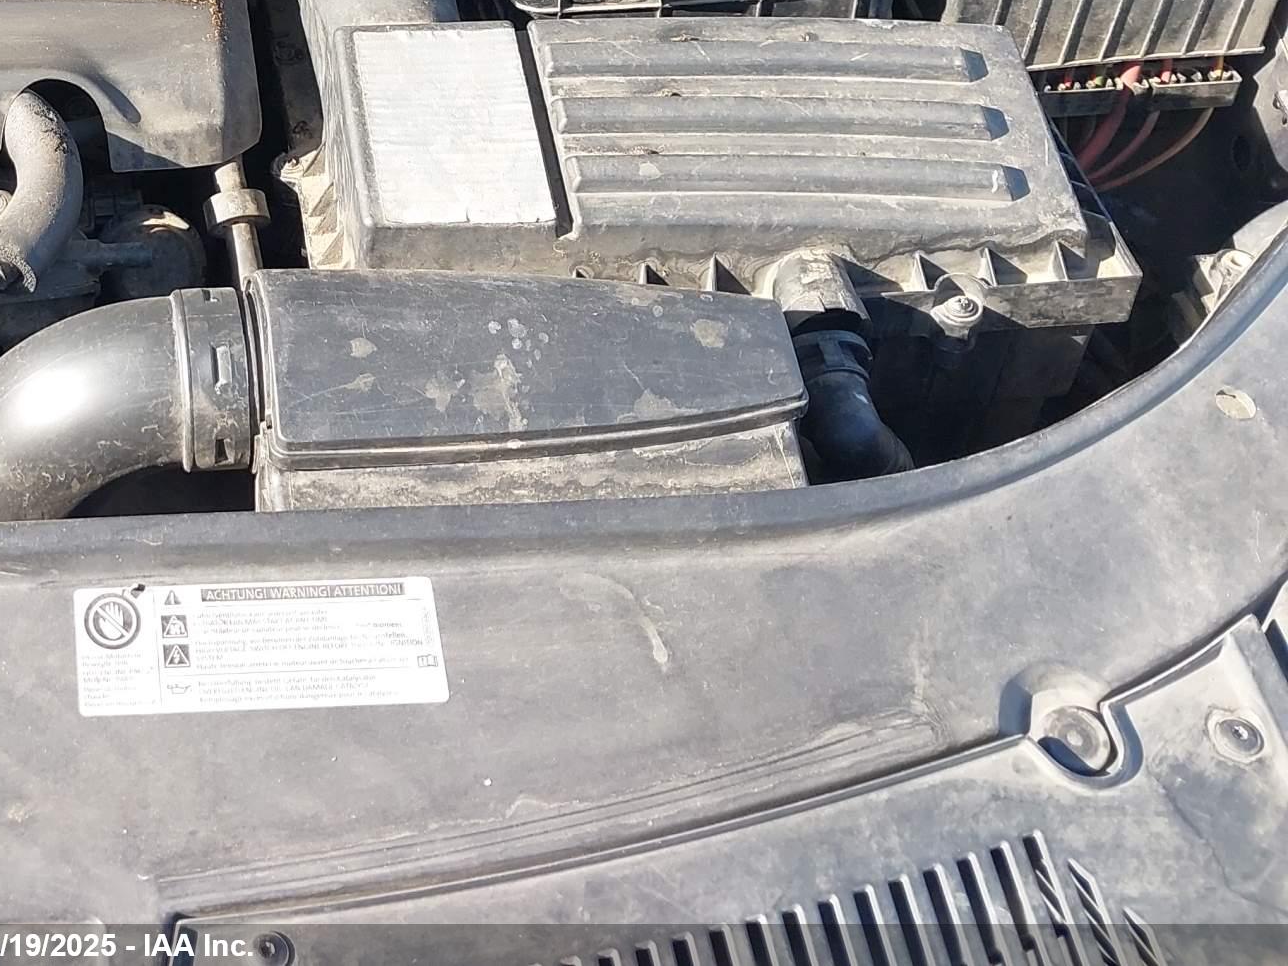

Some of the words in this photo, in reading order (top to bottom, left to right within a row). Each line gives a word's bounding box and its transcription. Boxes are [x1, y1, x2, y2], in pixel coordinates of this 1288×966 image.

[205, 587, 267, 601] ACHTUNG!
[270, 586, 330, 599] WARNING!
[333, 583, 401, 596] ATTENTION!
